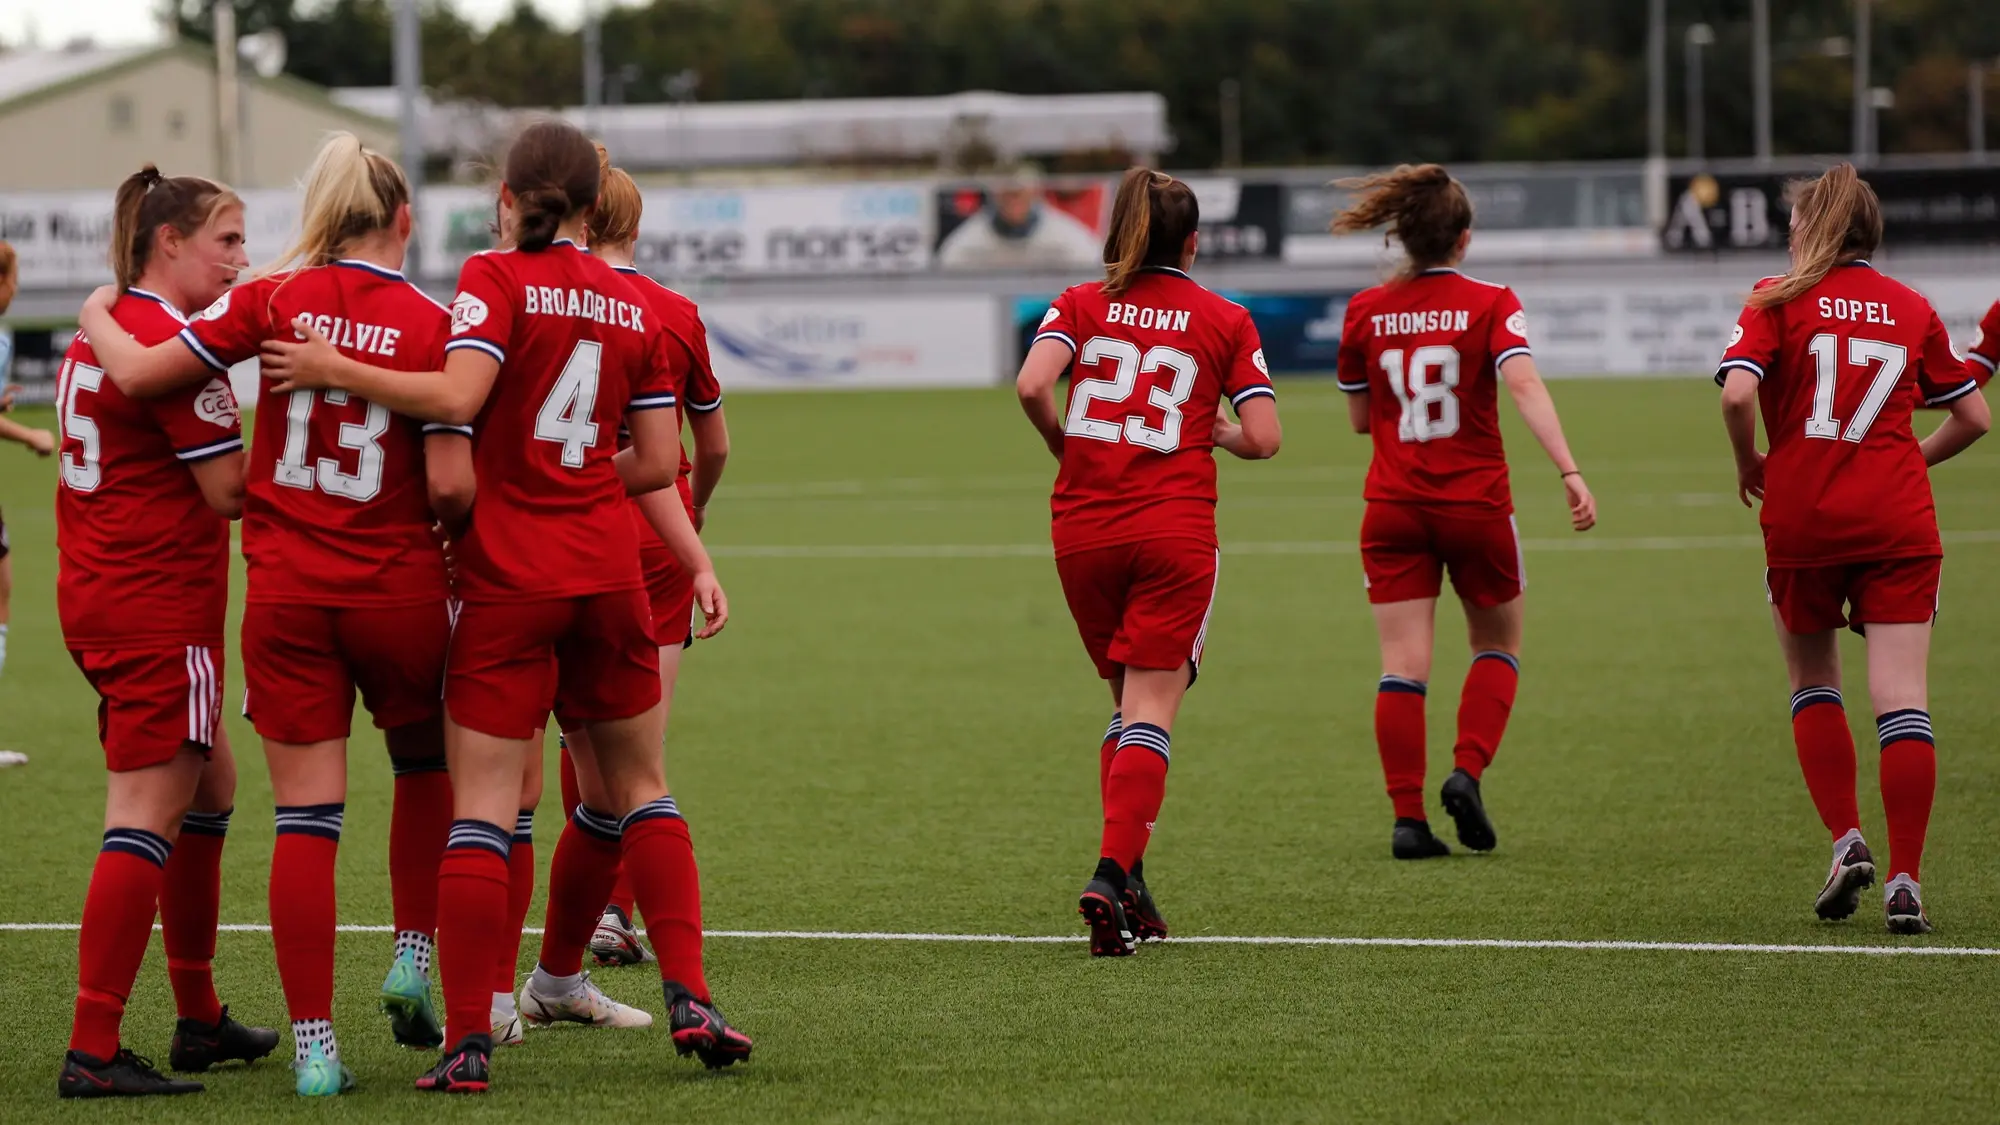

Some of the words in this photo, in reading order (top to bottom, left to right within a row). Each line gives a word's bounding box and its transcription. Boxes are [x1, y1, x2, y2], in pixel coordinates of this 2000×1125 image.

[634, 230, 743, 262] orse
[525, 285, 645, 333] BROADRICK
[1106, 302, 1191, 332] BROWN
[1371, 310, 1469, 337] THOMSON
[1818, 296, 1896, 327] SOPEL
[294, 312, 401, 357] OGILVIE
[534, 339, 603, 468] 4
[1064, 336, 1199, 453] 23
[1379, 345, 1460, 442] 18
[1805, 333, 1907, 443] 17
[273, 389, 391, 502] 13
